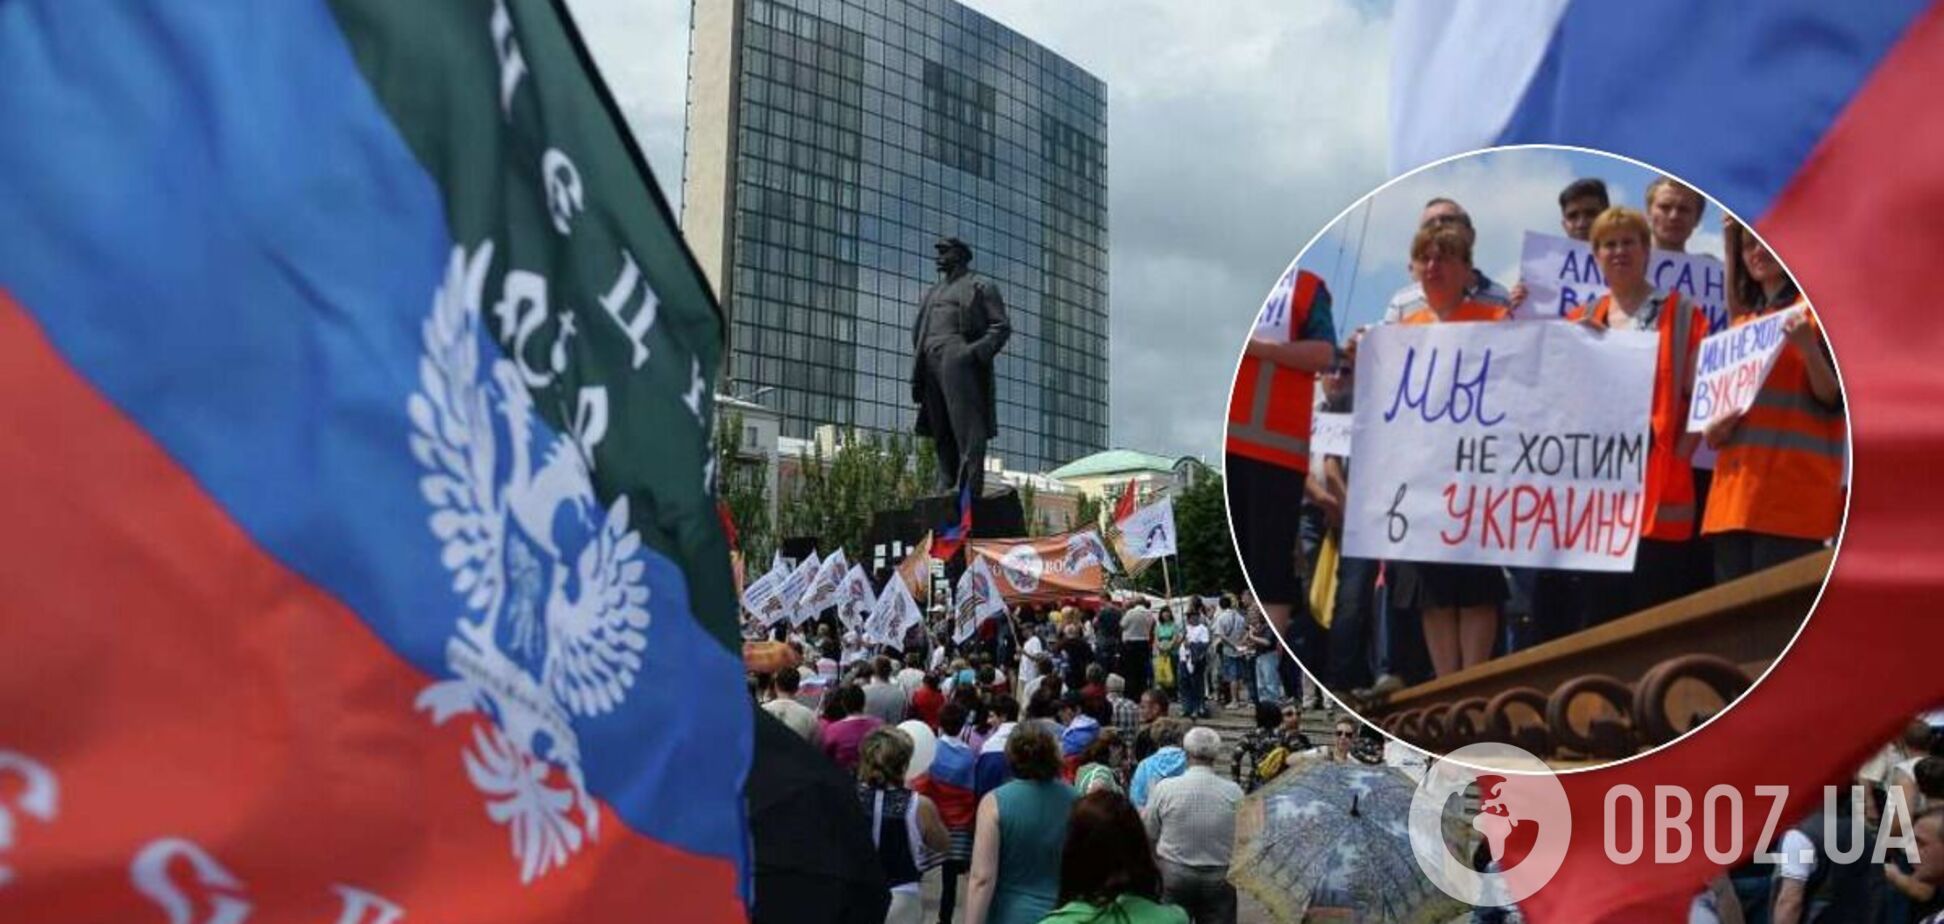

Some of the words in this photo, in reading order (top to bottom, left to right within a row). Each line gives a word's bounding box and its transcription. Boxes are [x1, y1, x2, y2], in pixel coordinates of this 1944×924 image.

[1455, 435, 1498, 474] НЕ
[1512, 432, 1643, 484] ХОТИМ
[1440, 482, 1641, 557] УКРАИНУ
